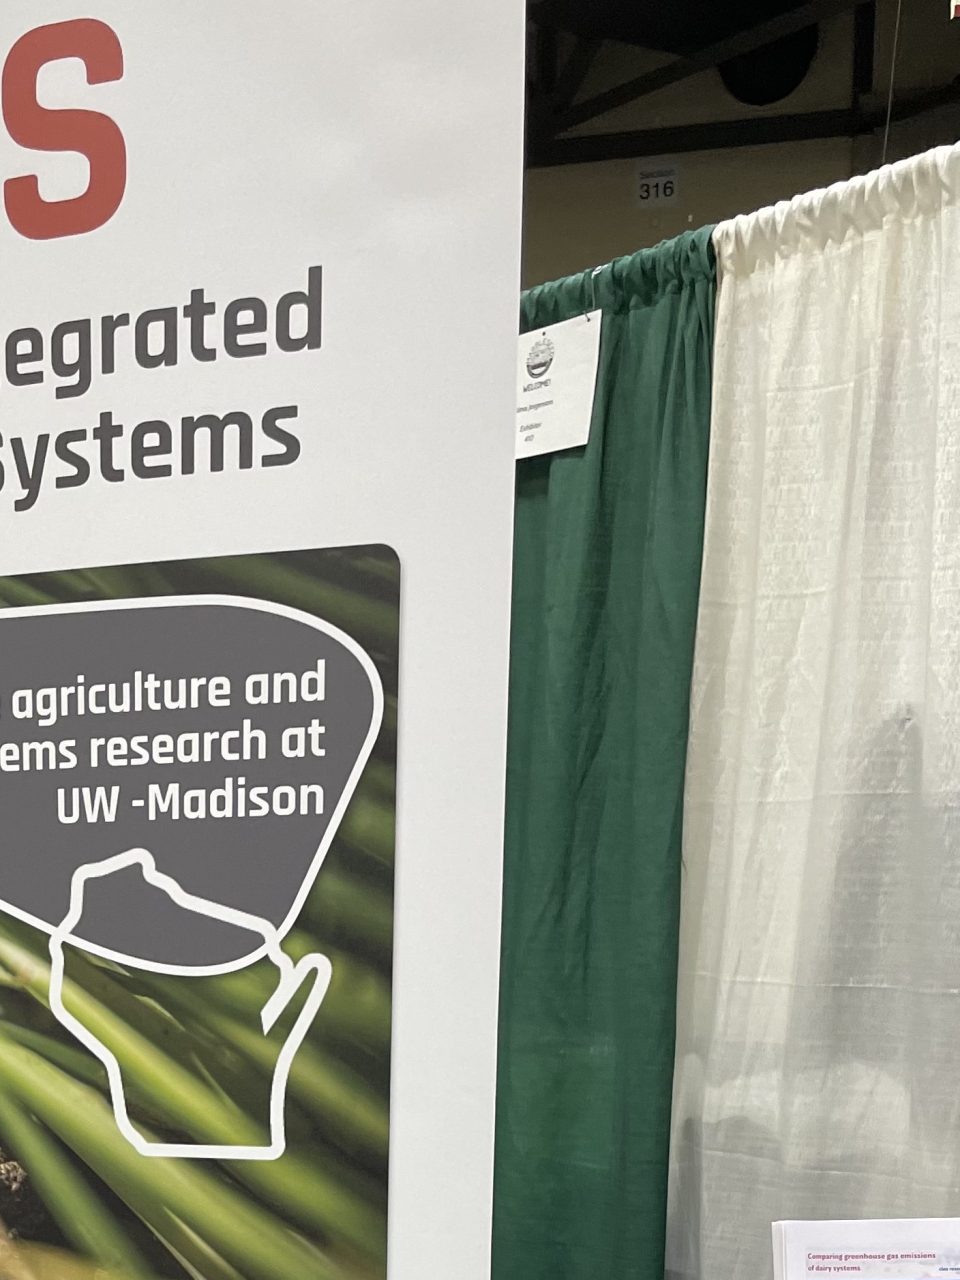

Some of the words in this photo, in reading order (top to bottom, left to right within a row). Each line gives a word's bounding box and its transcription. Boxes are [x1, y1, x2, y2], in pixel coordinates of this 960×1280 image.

[640, 181, 673, 200] 316
[12, 671, 230, 726] agriculture
[245, 659, 326, 704] and
[90, 719, 266, 768] research
[282, 718, 326, 759] at
[57, 786, 119, 824] UW
[132, 778, 324, 821] -Madison
[808, 1253, 844, 1261] Comparing
[845, 1253, 885, 1261] greenhouse
